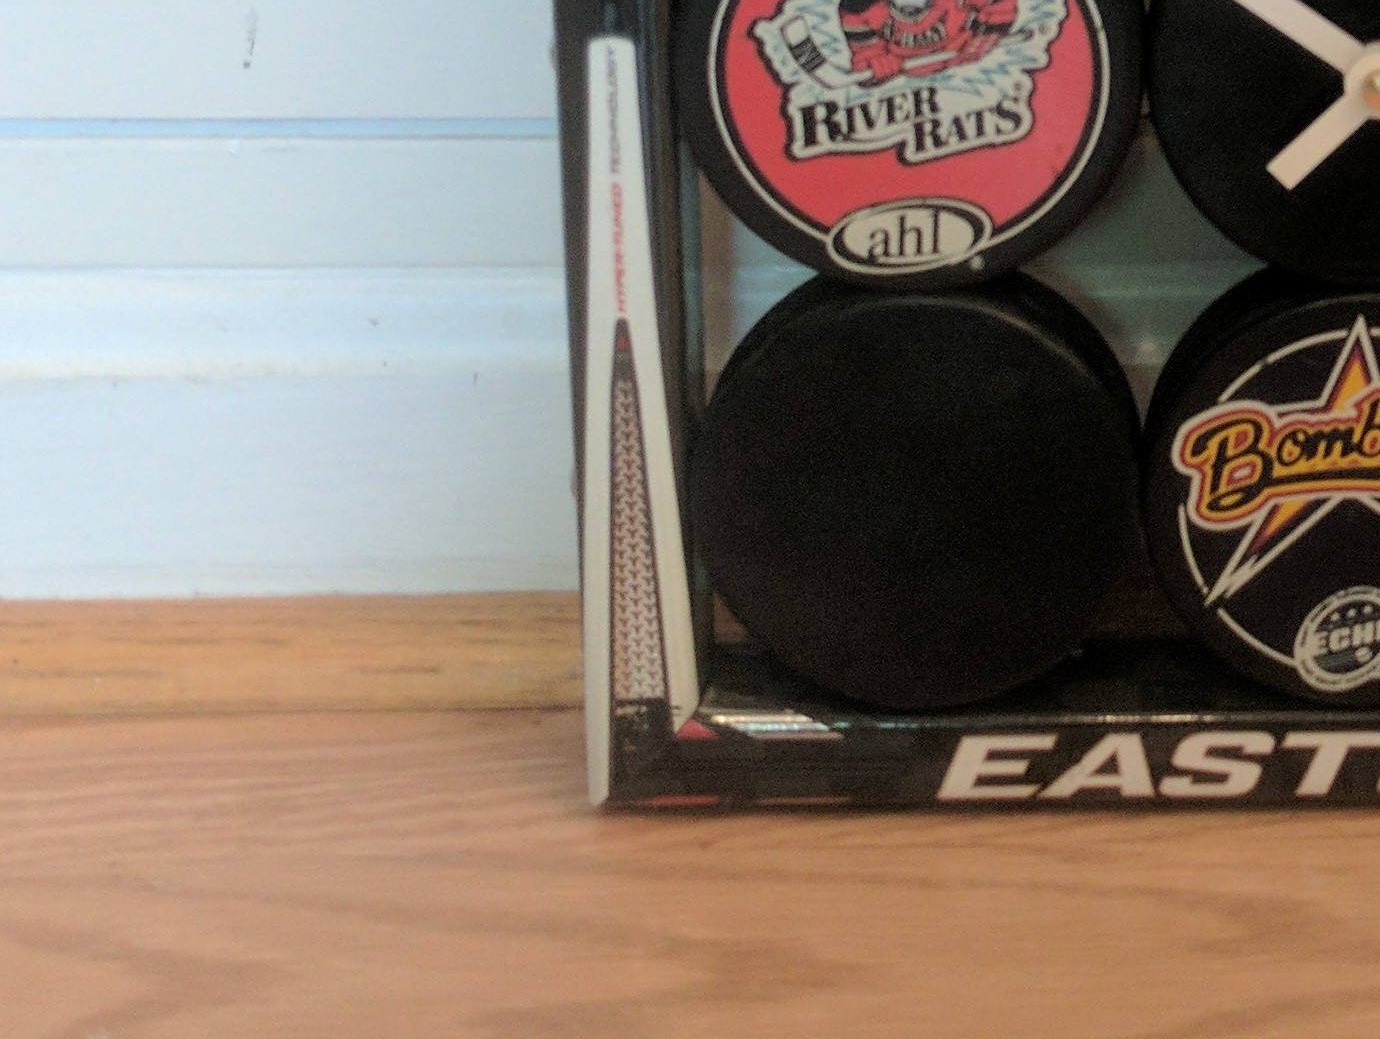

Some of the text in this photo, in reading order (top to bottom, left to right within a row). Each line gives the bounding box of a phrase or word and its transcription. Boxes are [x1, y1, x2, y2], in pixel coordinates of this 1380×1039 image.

[799, 86, 940, 148] RIVER
[913, 98, 1023, 153] RATS
[868, 207, 940, 262] ahl
